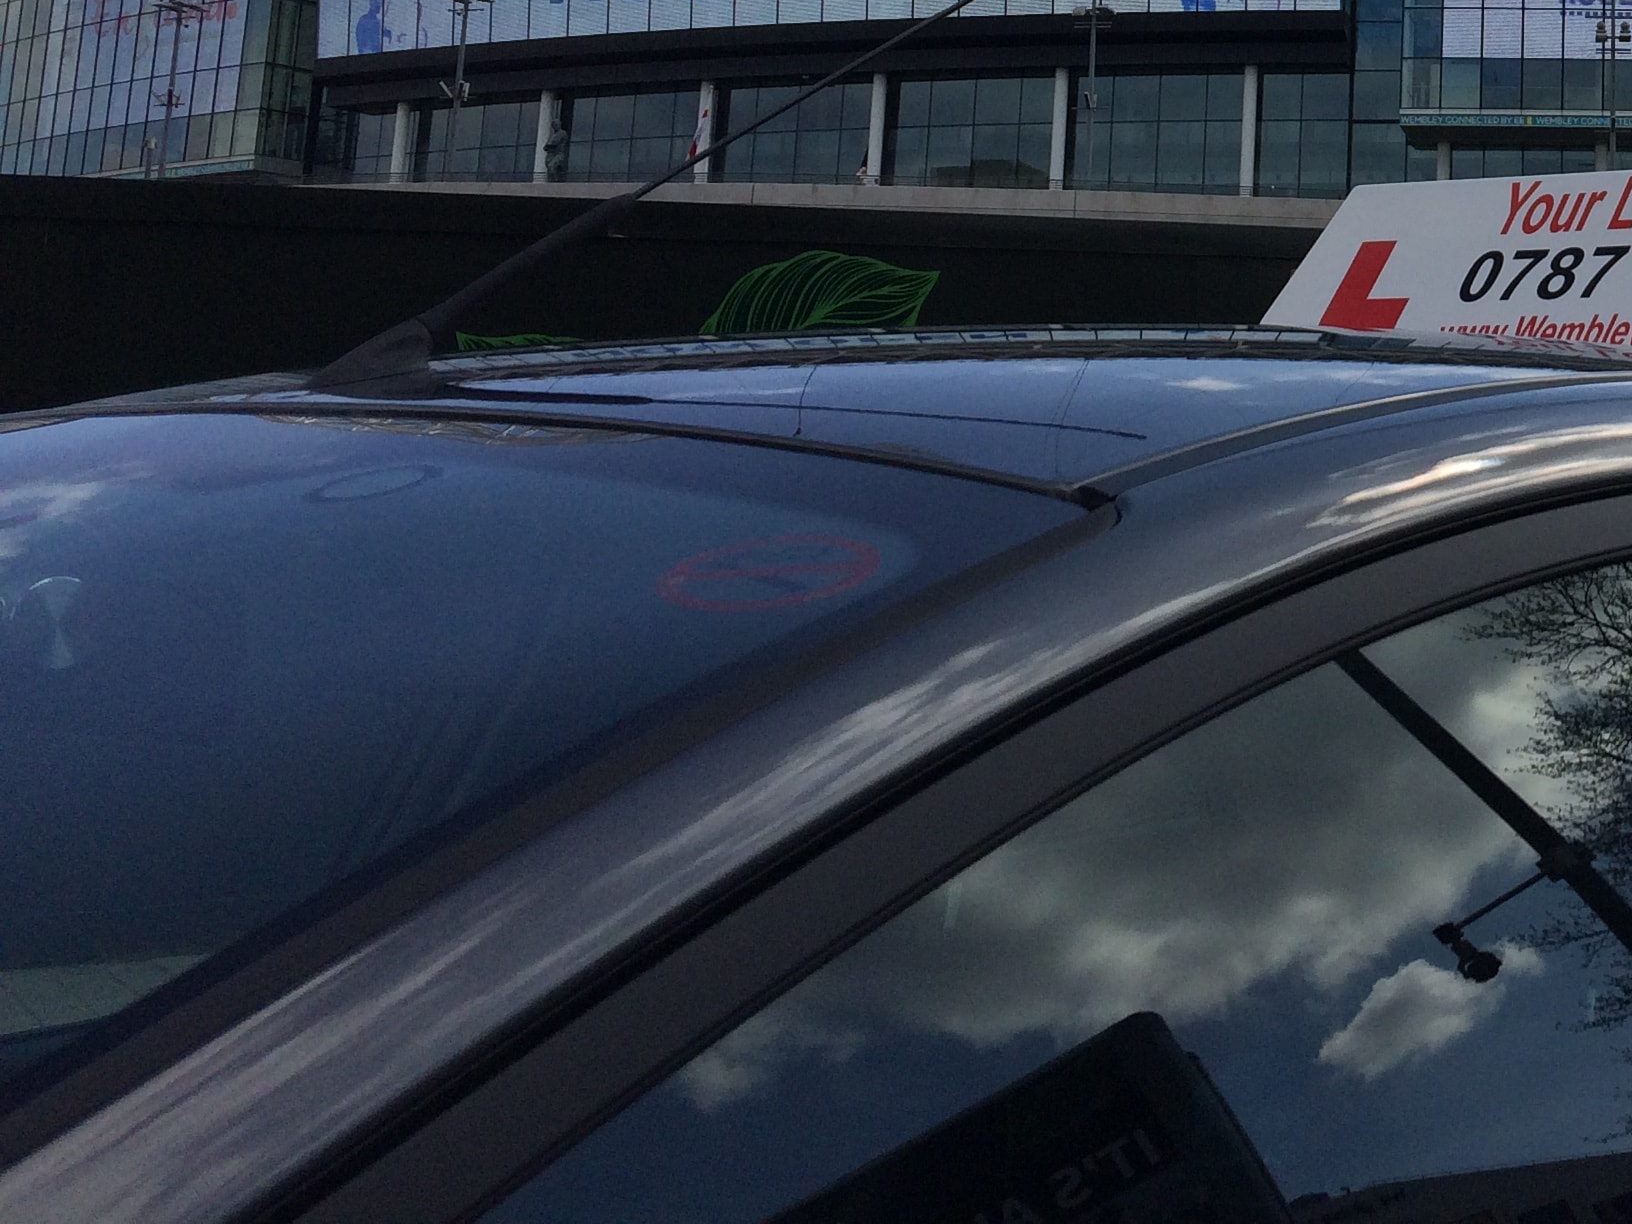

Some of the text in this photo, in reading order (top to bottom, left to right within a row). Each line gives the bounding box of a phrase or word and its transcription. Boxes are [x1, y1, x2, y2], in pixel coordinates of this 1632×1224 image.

[1400, 115, 1443, 124] WEMBLEY
[1443, 115, 1500, 124] CONNECTED
[1535, 117, 1579, 125] WEMBLEY
[1501, 180, 1608, 235] Your
[1318, 240, 1410, 332] L
[1459, 245, 1632, 302] 0787
